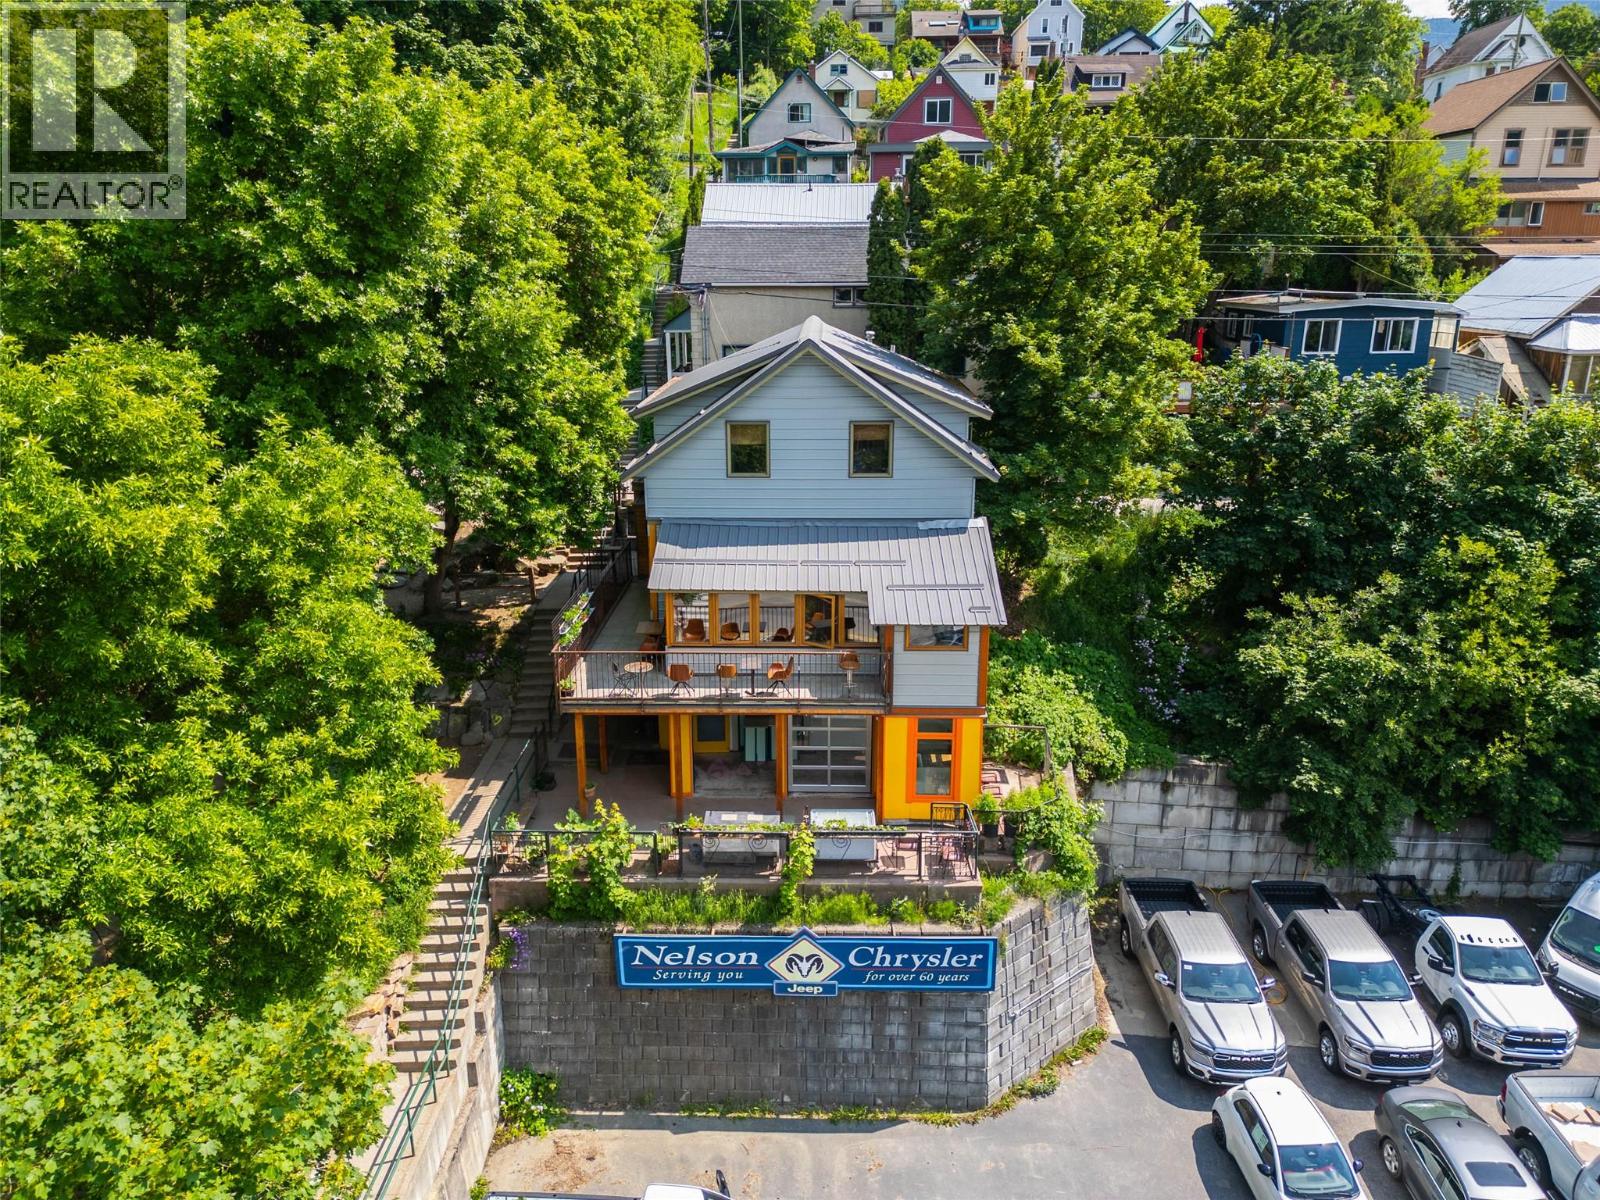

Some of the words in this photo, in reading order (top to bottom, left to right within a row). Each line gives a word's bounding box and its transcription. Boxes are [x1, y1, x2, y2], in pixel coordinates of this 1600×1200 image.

[631, 945, 758, 966] Nelson
[848, 946, 983, 971] Chrysler
[653, 969, 711, 982] Serving
[717, 971, 743, 982] you
[862, 971, 885, 983] for
[888, 973, 915, 982] over
[919, 972, 934, 981] 60
[937, 974, 969, 984] years
[787, 984, 823, 994] Jeep
